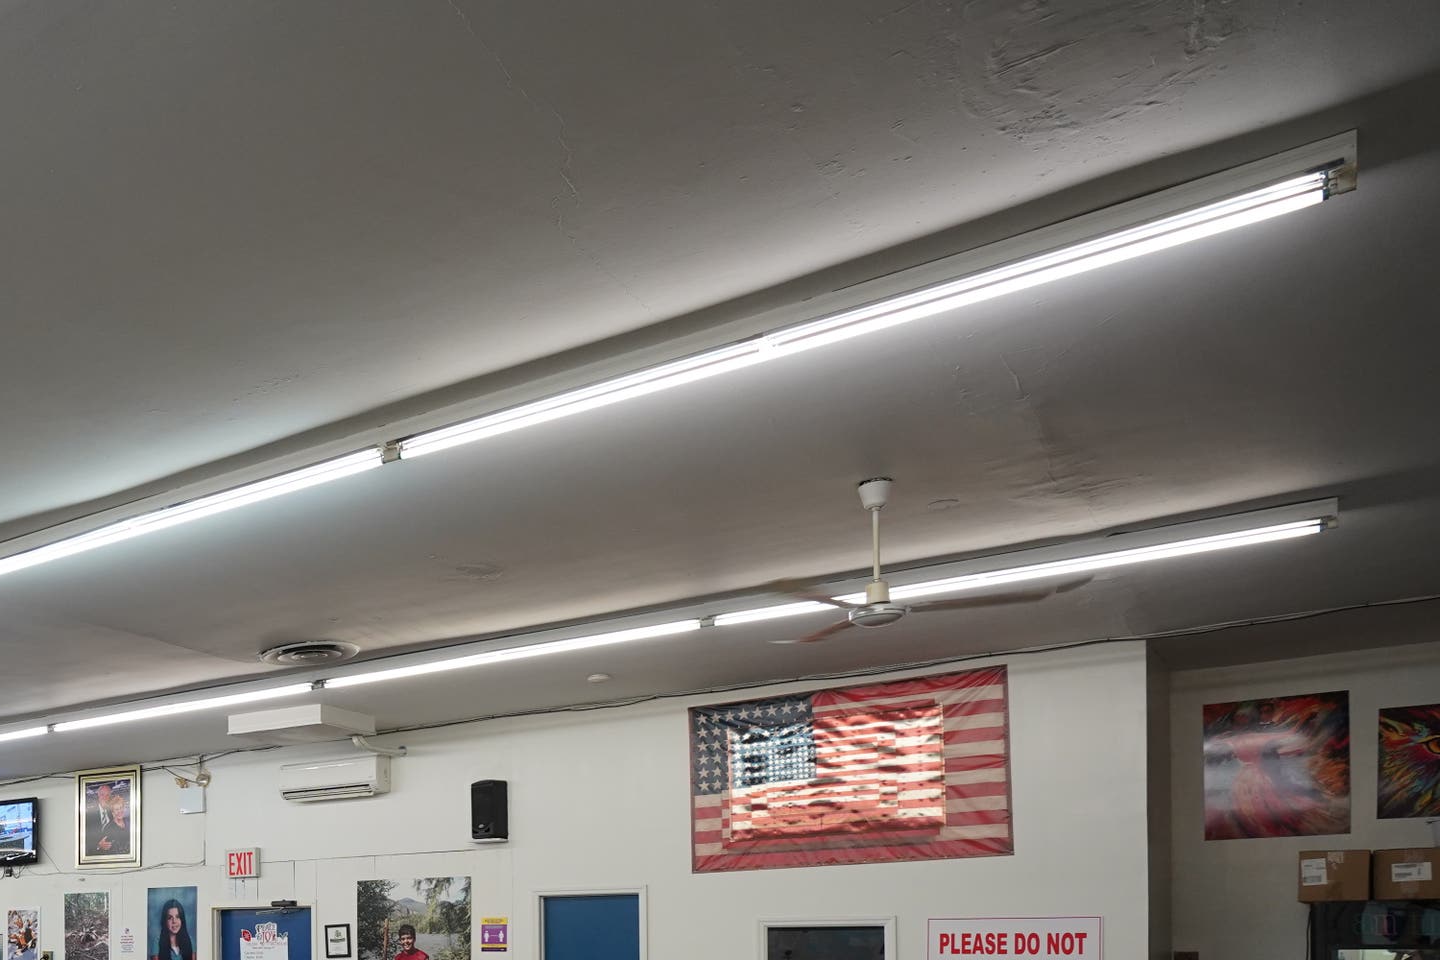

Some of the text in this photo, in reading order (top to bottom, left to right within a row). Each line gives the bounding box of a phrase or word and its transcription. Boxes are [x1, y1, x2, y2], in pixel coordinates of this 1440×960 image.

[228, 852, 253, 875] EXIT
[939, 932, 1087, 955] PLEASE DO NOT
